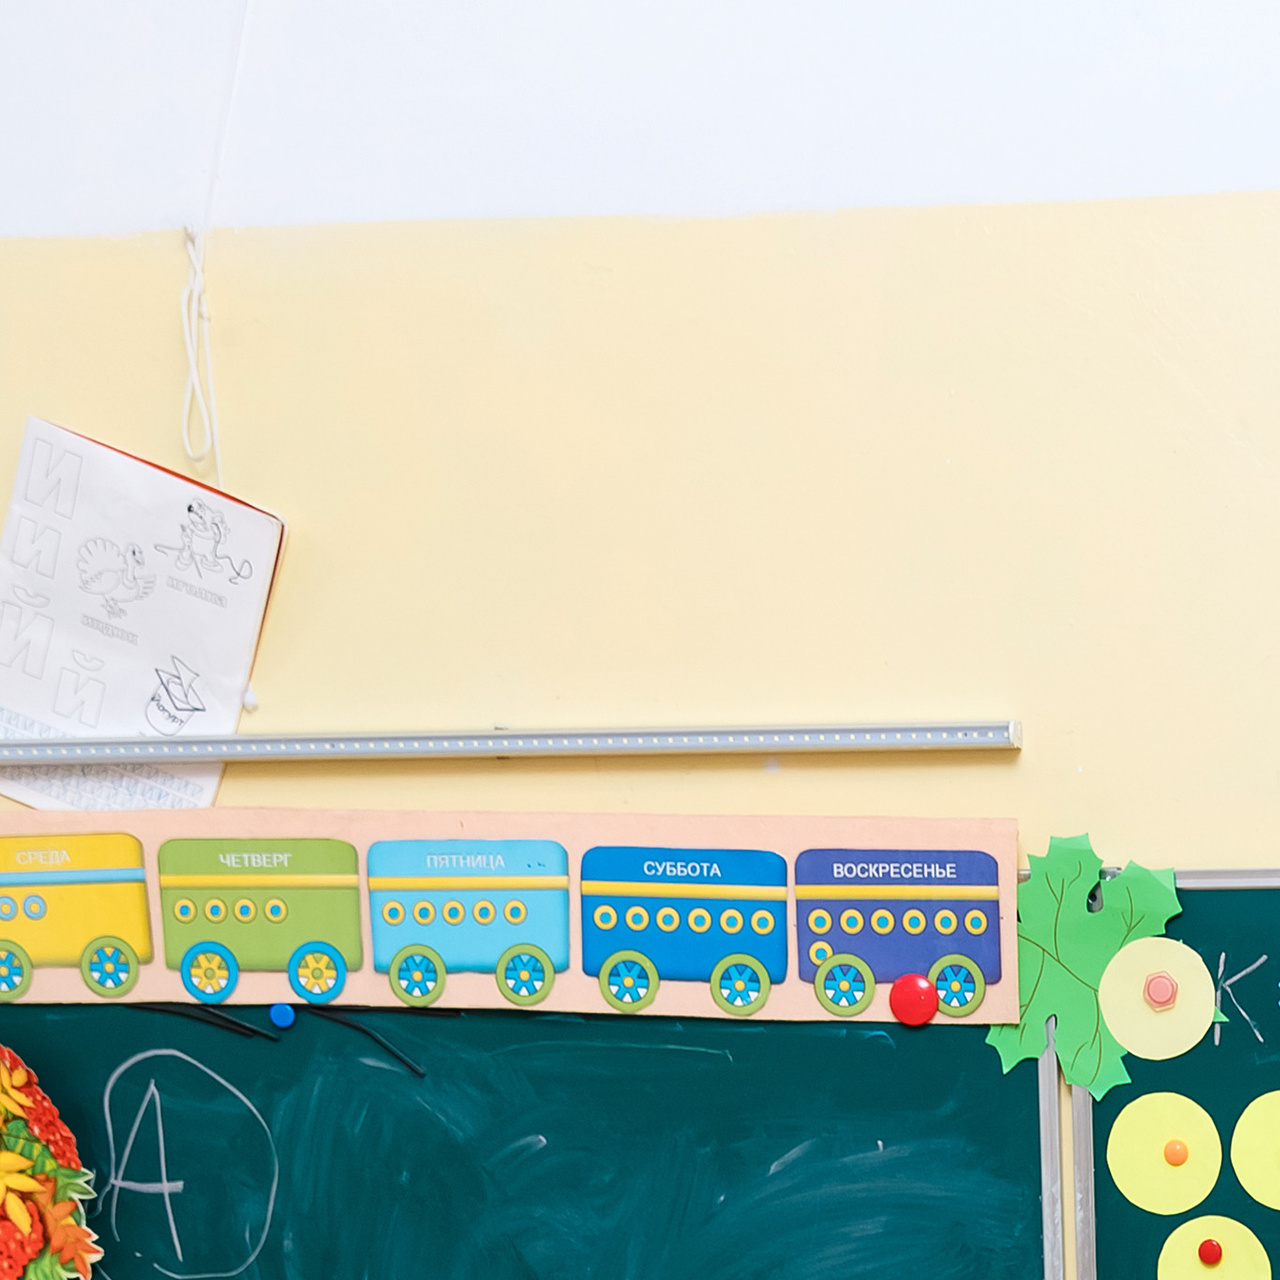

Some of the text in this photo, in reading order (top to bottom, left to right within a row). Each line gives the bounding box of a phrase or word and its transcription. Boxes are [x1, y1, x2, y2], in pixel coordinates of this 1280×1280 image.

[15, 849, 71, 866] СРЕДА
[219, 852, 292, 868] ЧЕТВЕРГ
[426, 854, 506, 870] ПЯТНИЦА
[643, 861, 721, 878] СУББОТА
[833, 863, 957, 879] ВОСКРЕСЕНЬЕ
